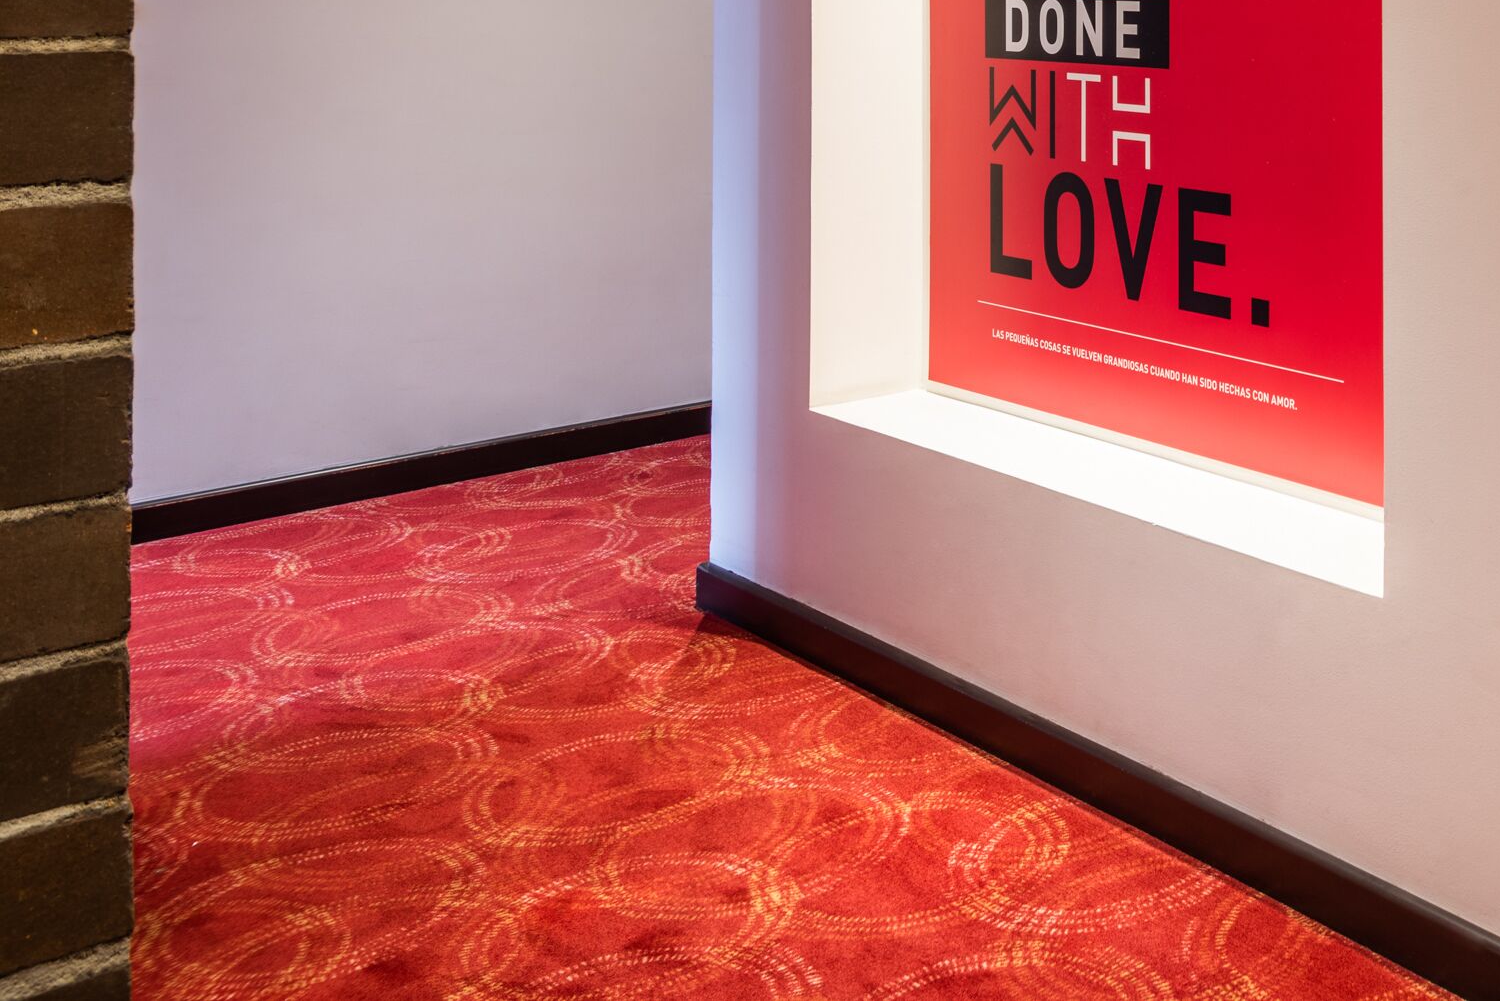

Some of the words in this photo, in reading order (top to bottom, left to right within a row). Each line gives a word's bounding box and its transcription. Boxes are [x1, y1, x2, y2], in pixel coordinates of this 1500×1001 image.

[989, 66, 1151, 170] WITH
[990, 163, 1270, 328] LOVE.
[992, 329, 1005, 340] LAS
[1005, 331, 1039, 348] PEQUEÑAS
[1039, 340, 1061, 353] COSAS
[1062, 345, 1071, 356] SE
[1072, 347, 1102, 363] VUELVEN
[1104, 354, 1149, 374] GRANDIOSAS
[1150, 365, 1181, 382] CUANDO
[1182, 373, 1198, 386] HAN
[1200, 377, 1217, 391] SIDO
[1219, 382, 1251, 399] HECHAS
[1252, 390, 1269, 403] CON
[1271, 395, 1298, 410] AMOR.
